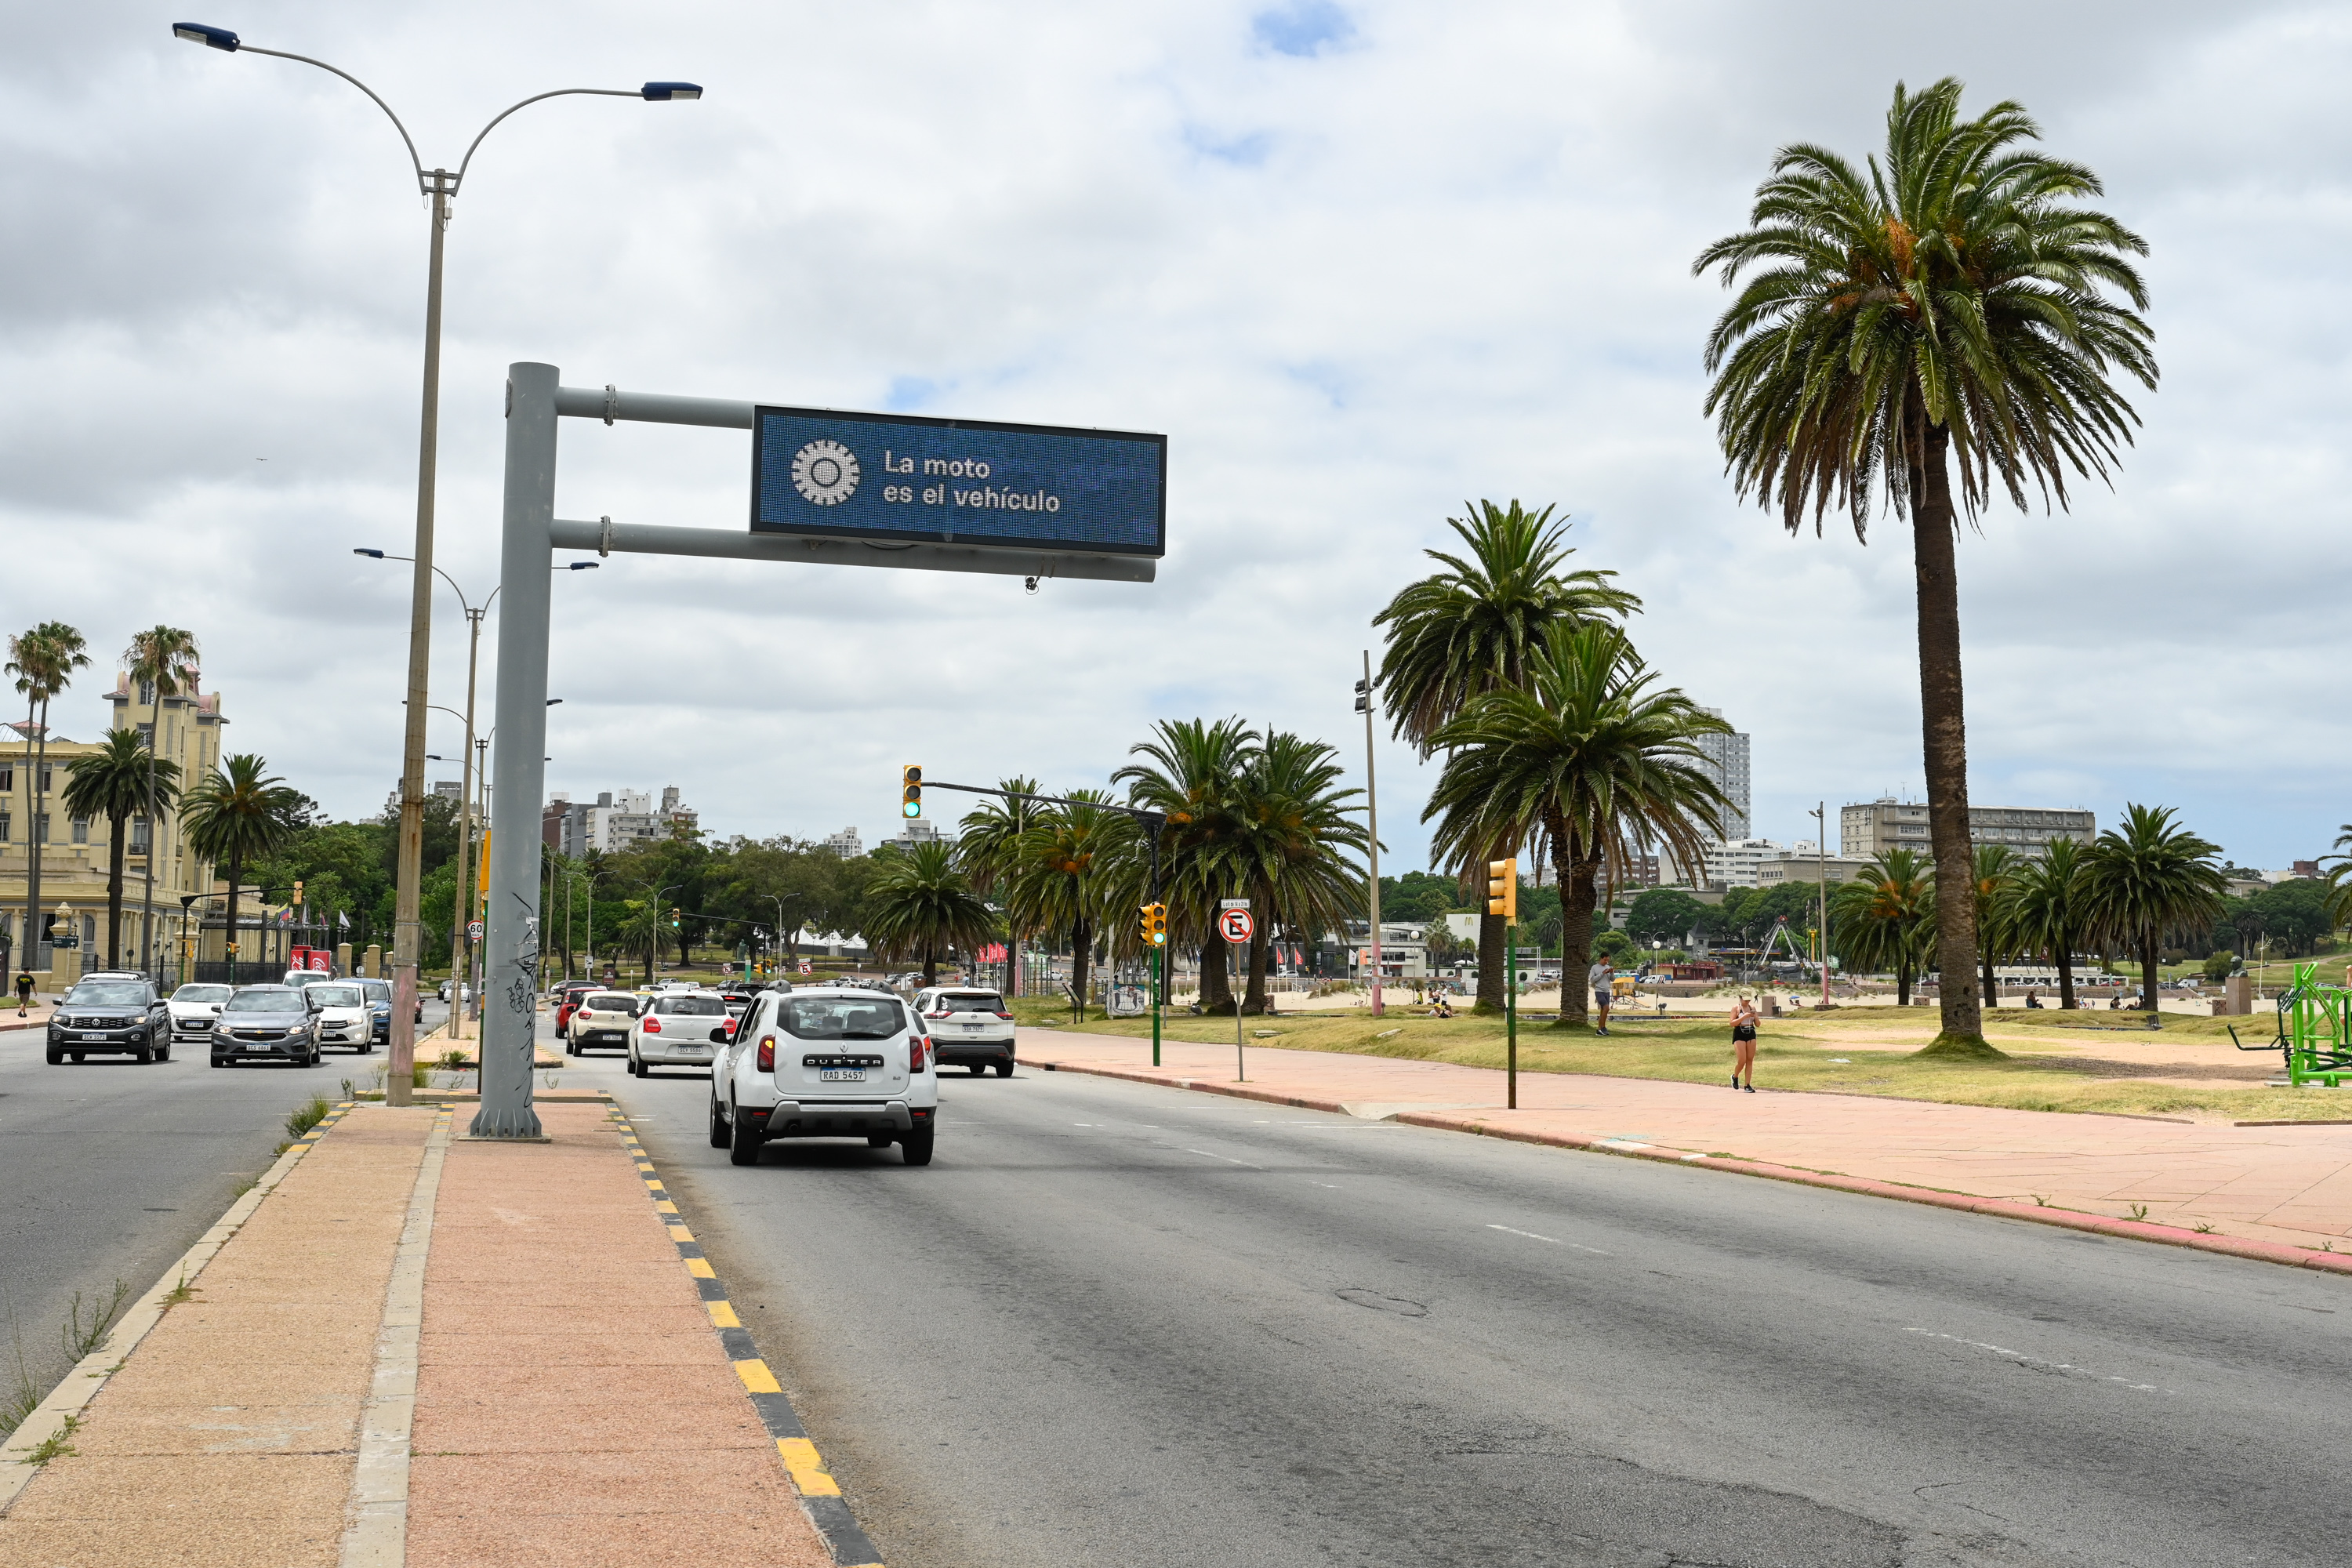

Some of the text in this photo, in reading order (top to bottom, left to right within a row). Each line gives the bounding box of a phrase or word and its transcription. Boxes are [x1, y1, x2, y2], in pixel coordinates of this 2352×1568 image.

[885, 450, 989, 478] La moto
[884, 484, 1059, 512] es el vehículo
[470, 924, 482, 933] 60
[823, 1071, 863, 1080] RAD 5457
